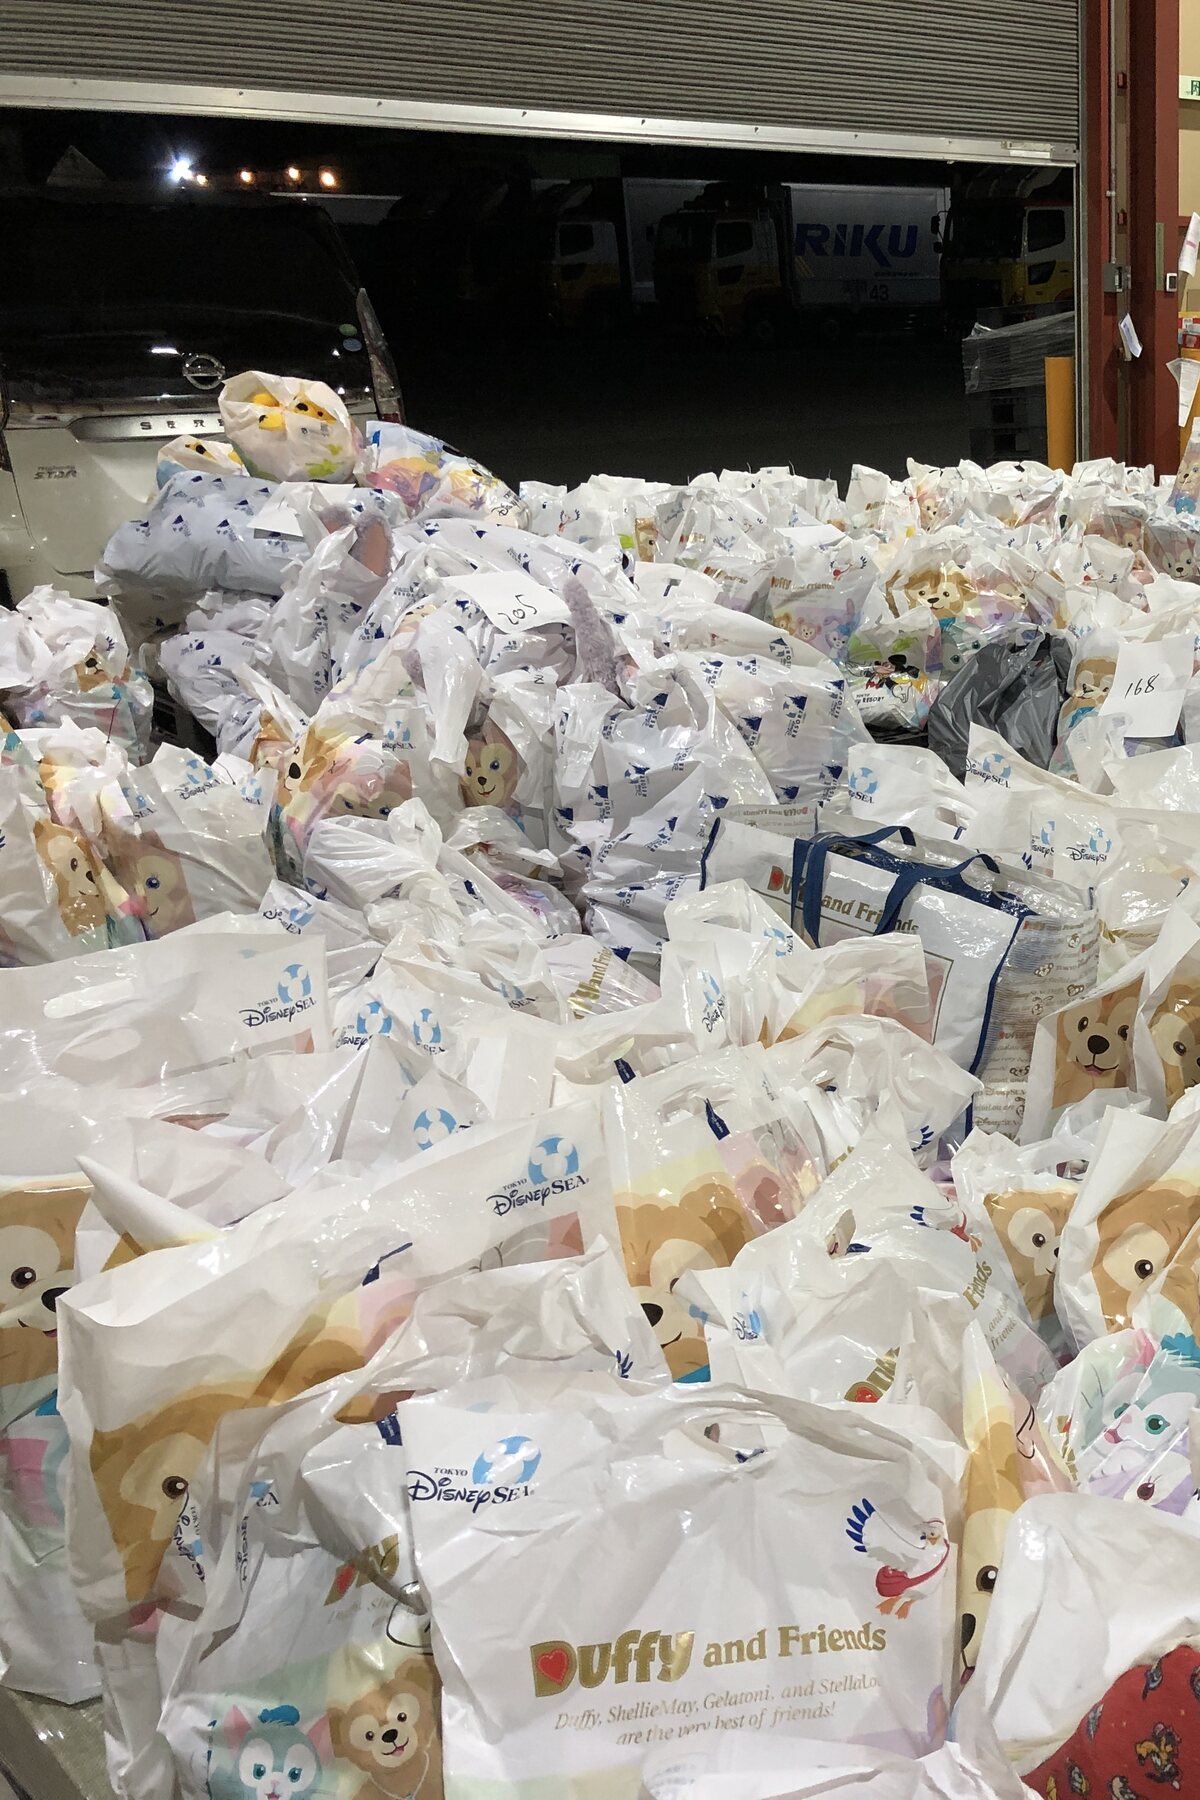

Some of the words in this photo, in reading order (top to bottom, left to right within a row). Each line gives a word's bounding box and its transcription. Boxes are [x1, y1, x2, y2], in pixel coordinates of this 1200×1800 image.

[795, 223, 919, 268] RIKU
[869, 284, 890, 302] 43
[1125, 673, 1160, 699] 168
[820, 892, 852, 918] and
[855, 902, 919, 935] Frinds
[486, 1174, 586, 1217] DisneySEA
[502, 1178, 527, 1191] TOKYO
[406, 1471, 530, 1513] DisneySEA
[433, 1466, 468, 1477] TOKYO
[529, 1629, 696, 1698] Duffy
[703, 1629, 768, 1668] and
[777, 1622, 887, 1658] Friends
[781, 1682, 815, 1700] and
[615, 1728, 642, 1746] are
[714, 1712, 747, 1731] best
[748, 1708, 768, 1732] of
[769, 1702, 836, 1732] friends!
